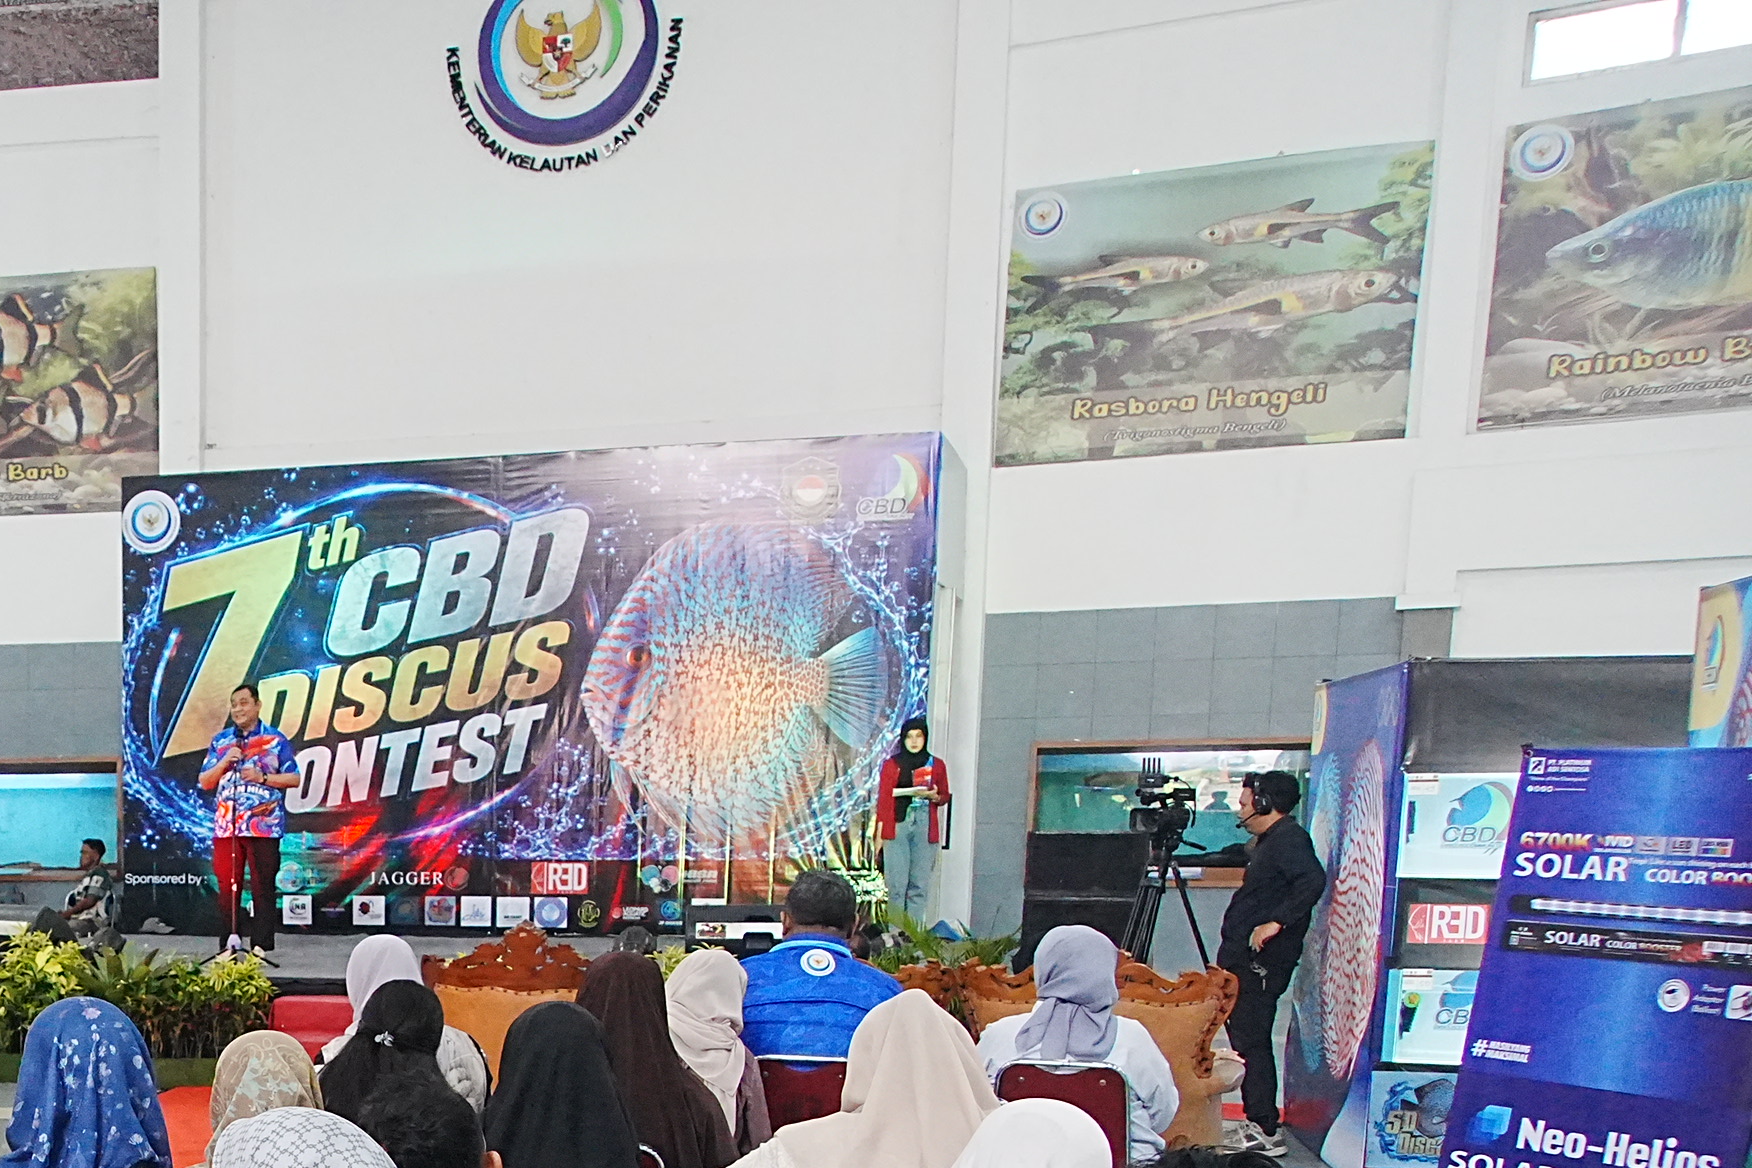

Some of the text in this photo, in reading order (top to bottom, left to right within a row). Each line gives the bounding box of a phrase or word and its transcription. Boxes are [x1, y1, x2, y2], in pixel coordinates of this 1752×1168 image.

[446, 46, 507, 161] KEMENTERIAN
[506, 148, 598, 172] KELAUTAN
[634, 17, 684, 129] PERIKANAN
[1547, 347, 1709, 379] Rainbow
[1070, 382, 1328, 421] Rasbora Hengeli
[6, 462, 69, 481] Barb
[856, 497, 906, 514] CBD
[326, 507, 590, 657] CBD
[256, 620, 570, 741] DISCUS
[285, 703, 548, 814] ONTEST
[1442, 826, 1497, 843] CBD
[1520, 831, 1594, 850] 6700K
[1512, 852, 1629, 882] SOLAR
[1644, 868, 1708, 885] COLOR
[124, 873, 186, 885] Sponsored
[369, 871, 444, 886] JAGGER
[1544, 930, 1600, 947] SOLAR
